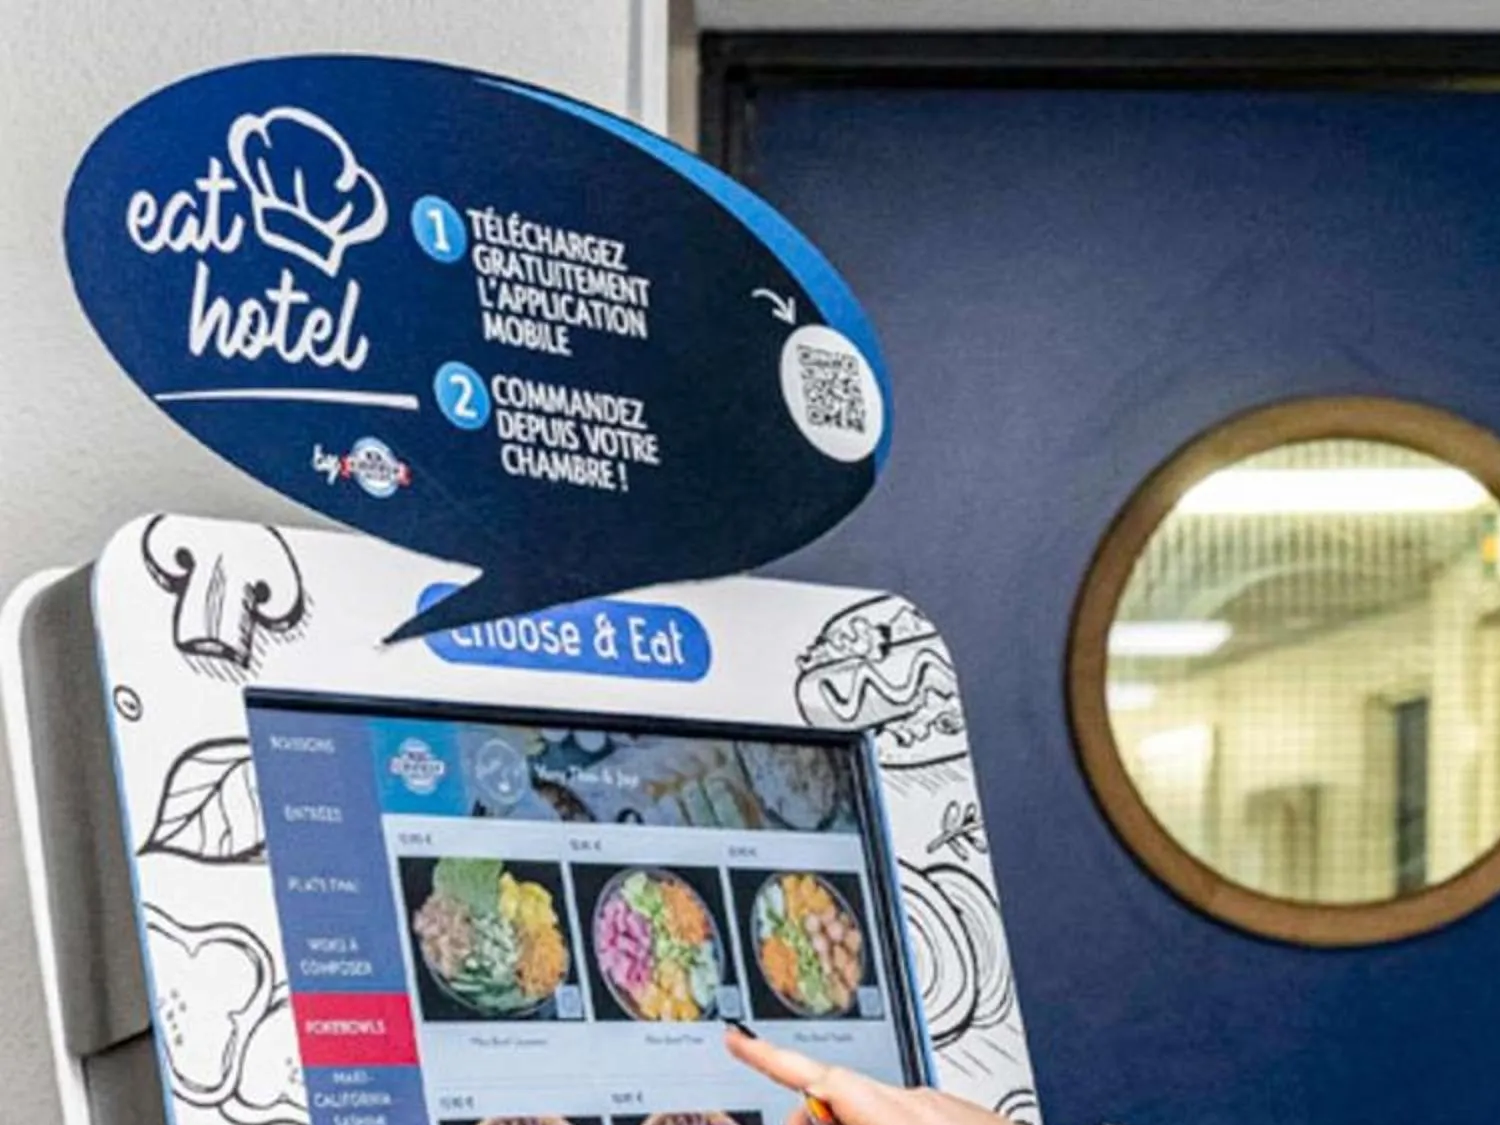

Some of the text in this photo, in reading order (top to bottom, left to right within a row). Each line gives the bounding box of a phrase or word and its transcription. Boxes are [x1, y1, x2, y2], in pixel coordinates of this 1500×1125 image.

[126, 156, 244, 253] eat
[427, 207, 450, 253] 1
[466, 206, 628, 272] TÉLÉCHARGEZ
[472, 244, 650, 307] GRATUITEMENT
[189, 259, 369, 372] hotel
[477, 276, 648, 339] L'APPLICATION
[482, 311, 573, 357] MOBILE
[449, 373, 478, 419] 2
[491, 374, 648, 429] COMMANDEZ
[496, 407, 662, 466] DEPUIS VOTRE
[313, 443, 341, 486] by
[501, 443, 617, 491] CHAMBRE
[592, 612, 619, 660] &
[627, 615, 687, 665] Eat
